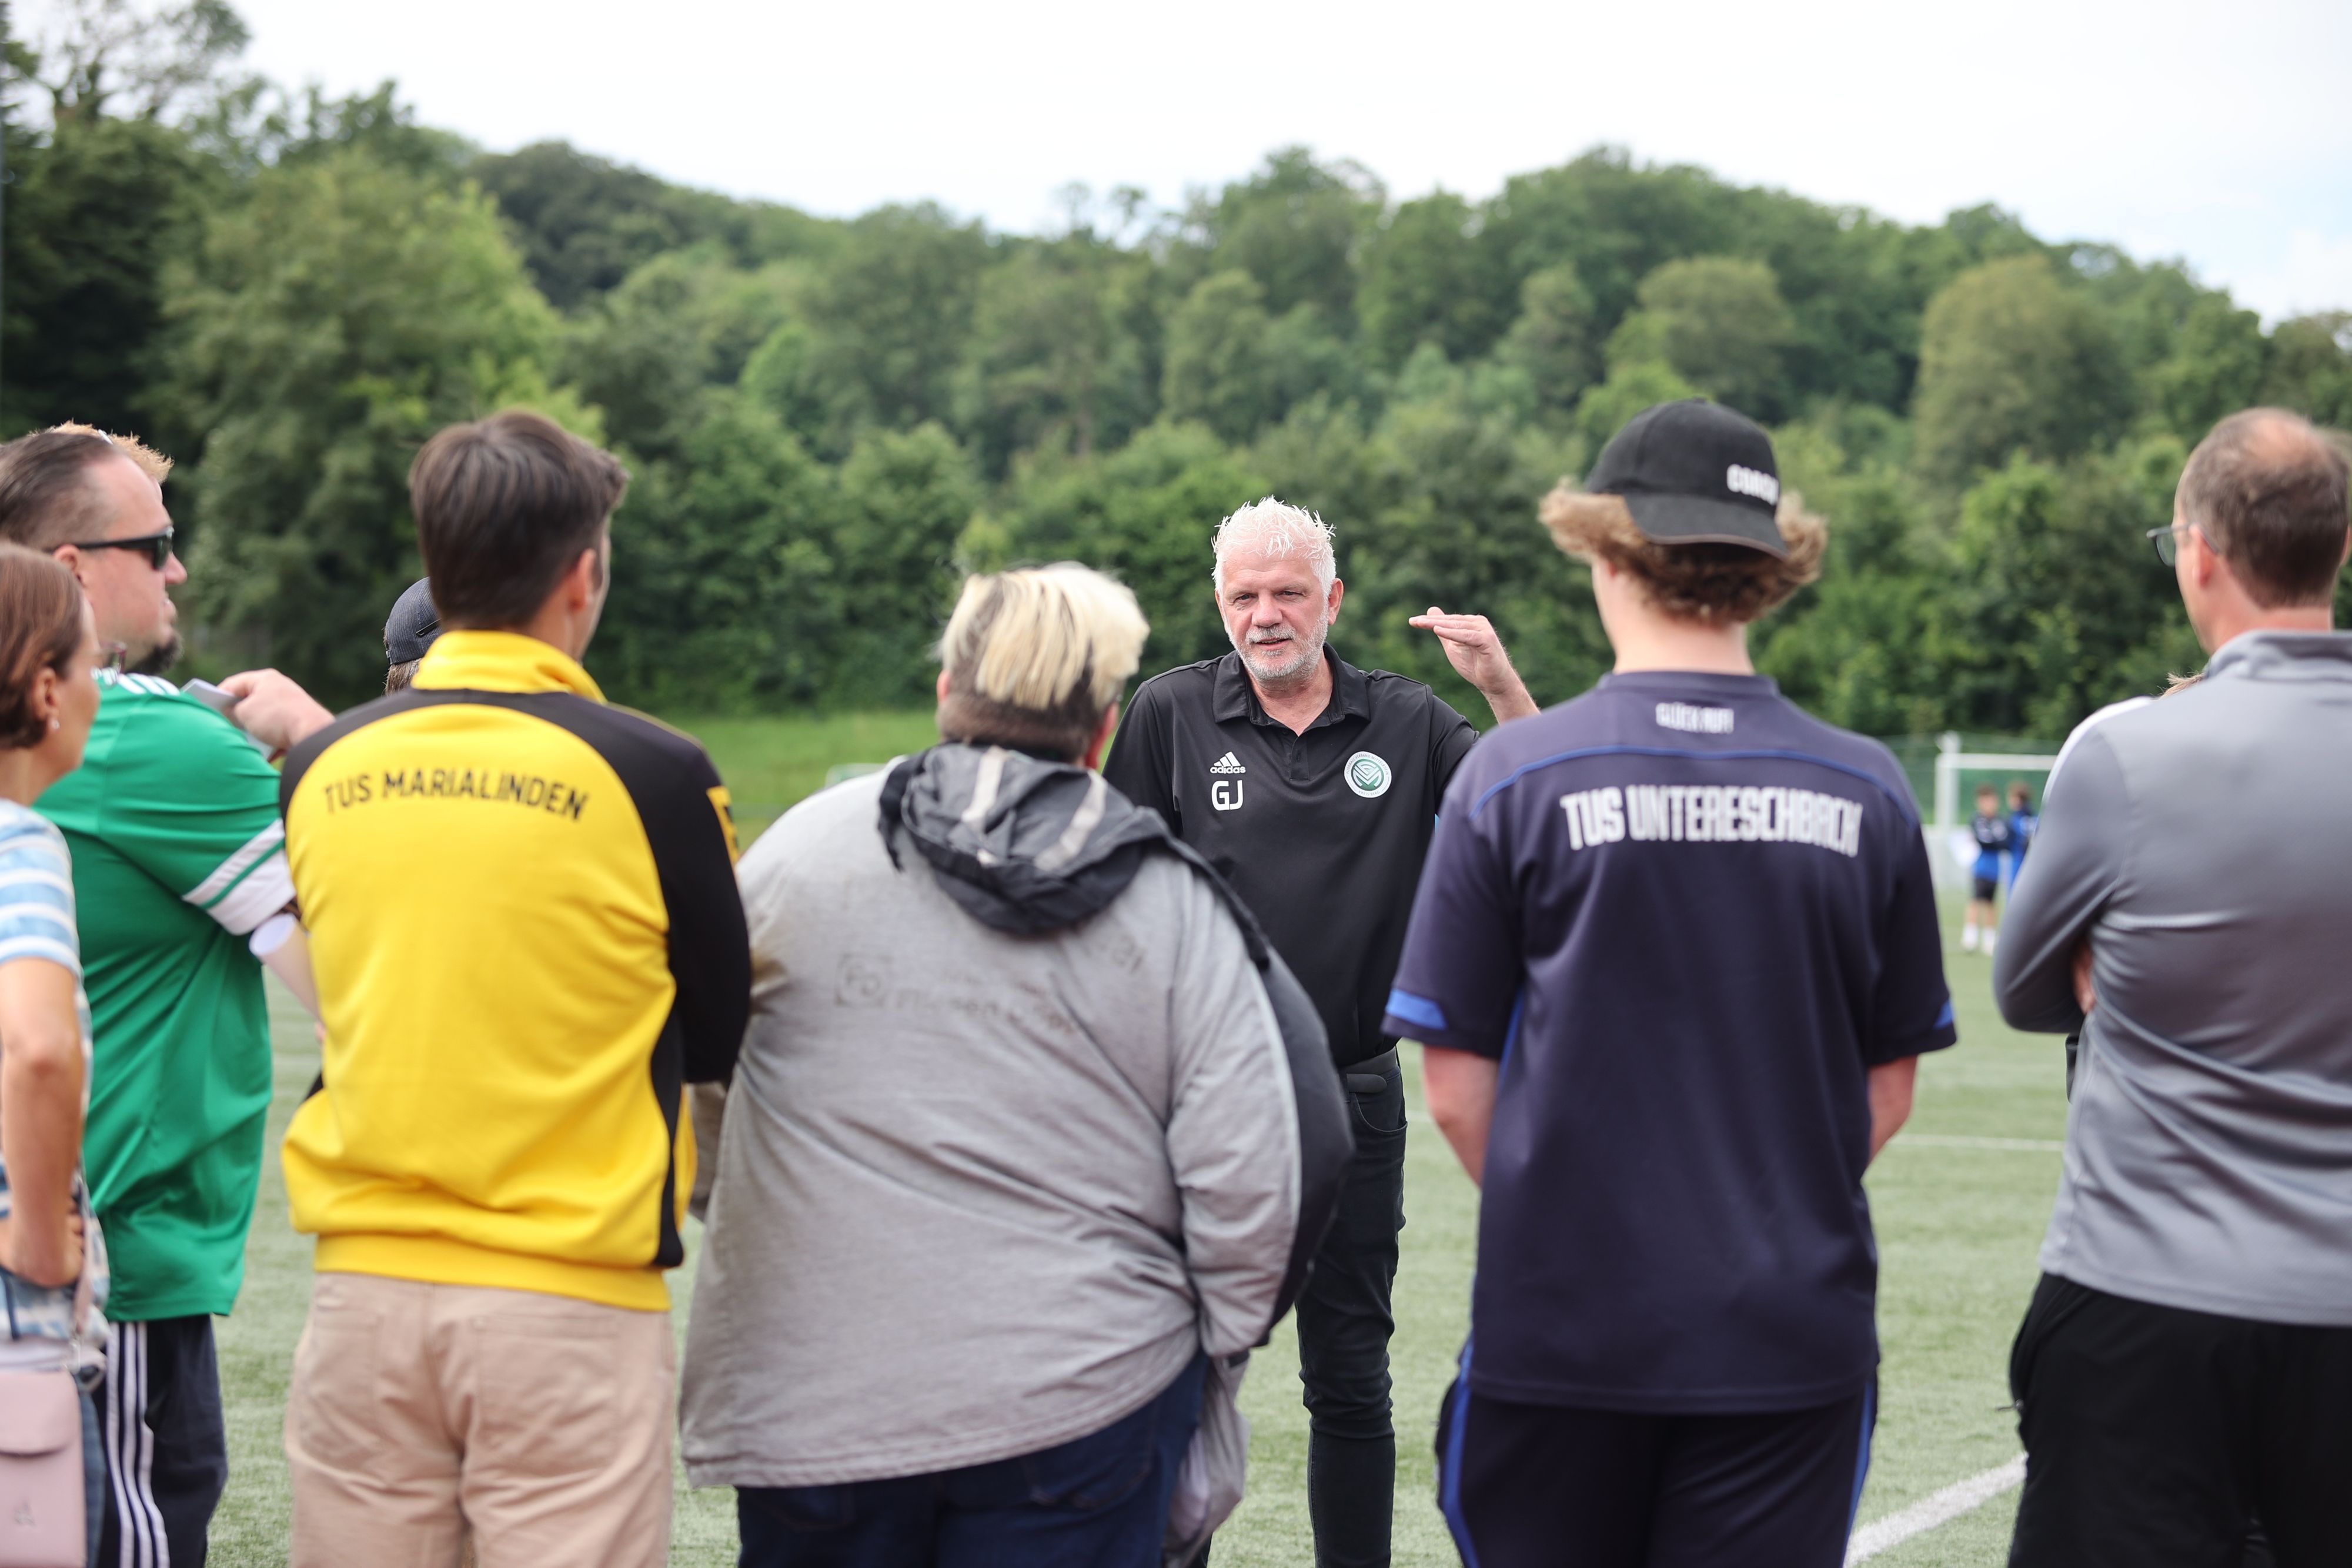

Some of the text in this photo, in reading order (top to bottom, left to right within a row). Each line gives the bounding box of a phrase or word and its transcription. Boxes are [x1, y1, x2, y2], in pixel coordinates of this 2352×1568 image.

[1210, 766, 1246, 774] adidas
[325, 767, 589, 821] TUS MARIALINDEN
[1211, 780, 1244, 811] GJ
[1560, 785, 1863, 858] TUS UNTERESCHBACH
